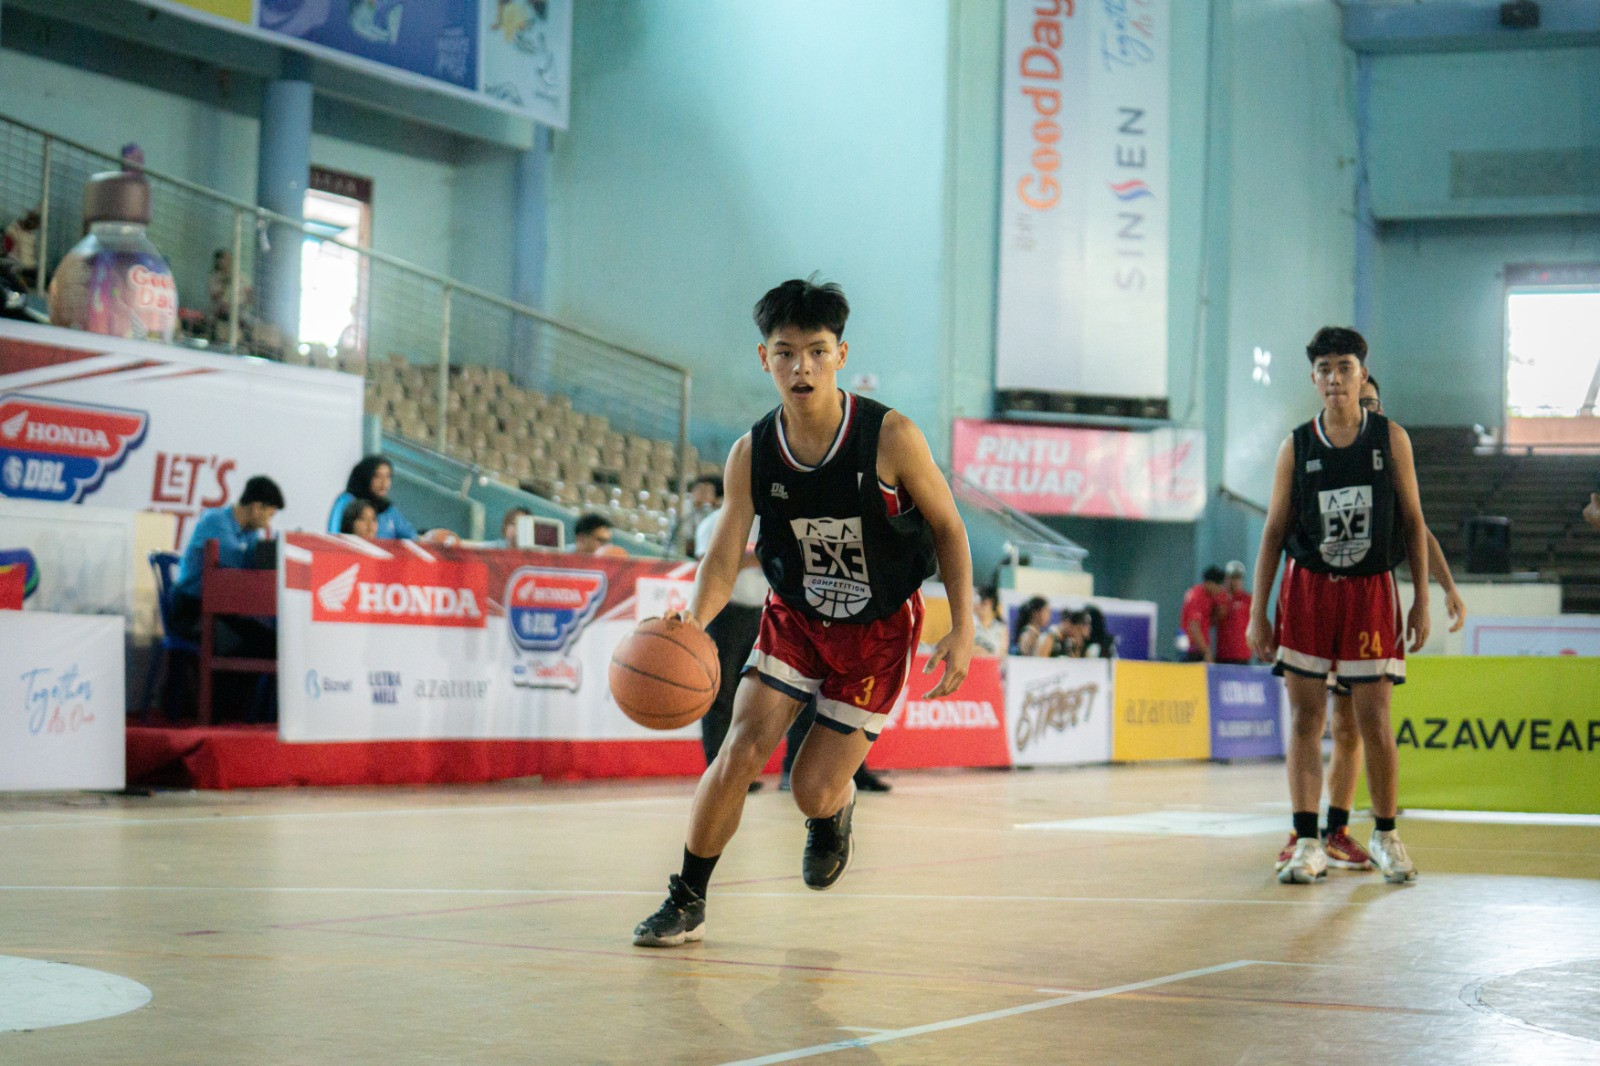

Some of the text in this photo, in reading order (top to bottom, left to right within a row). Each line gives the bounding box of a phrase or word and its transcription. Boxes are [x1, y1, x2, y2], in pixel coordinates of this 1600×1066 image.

[26, 420, 111, 450] HONDA
[976, 434, 1071, 467] PINTU
[23, 458, 67, 493] DBL
[151, 450, 237, 508] LET'S
[965, 462, 1085, 496] KELUAR
[358, 581, 483, 618] HONDA
[811, 578, 866, 594] COMPETITION
[1359, 630, 1383, 658] 24
[854, 675, 876, 706] 3
[905, 700, 1000, 729] HONDA
